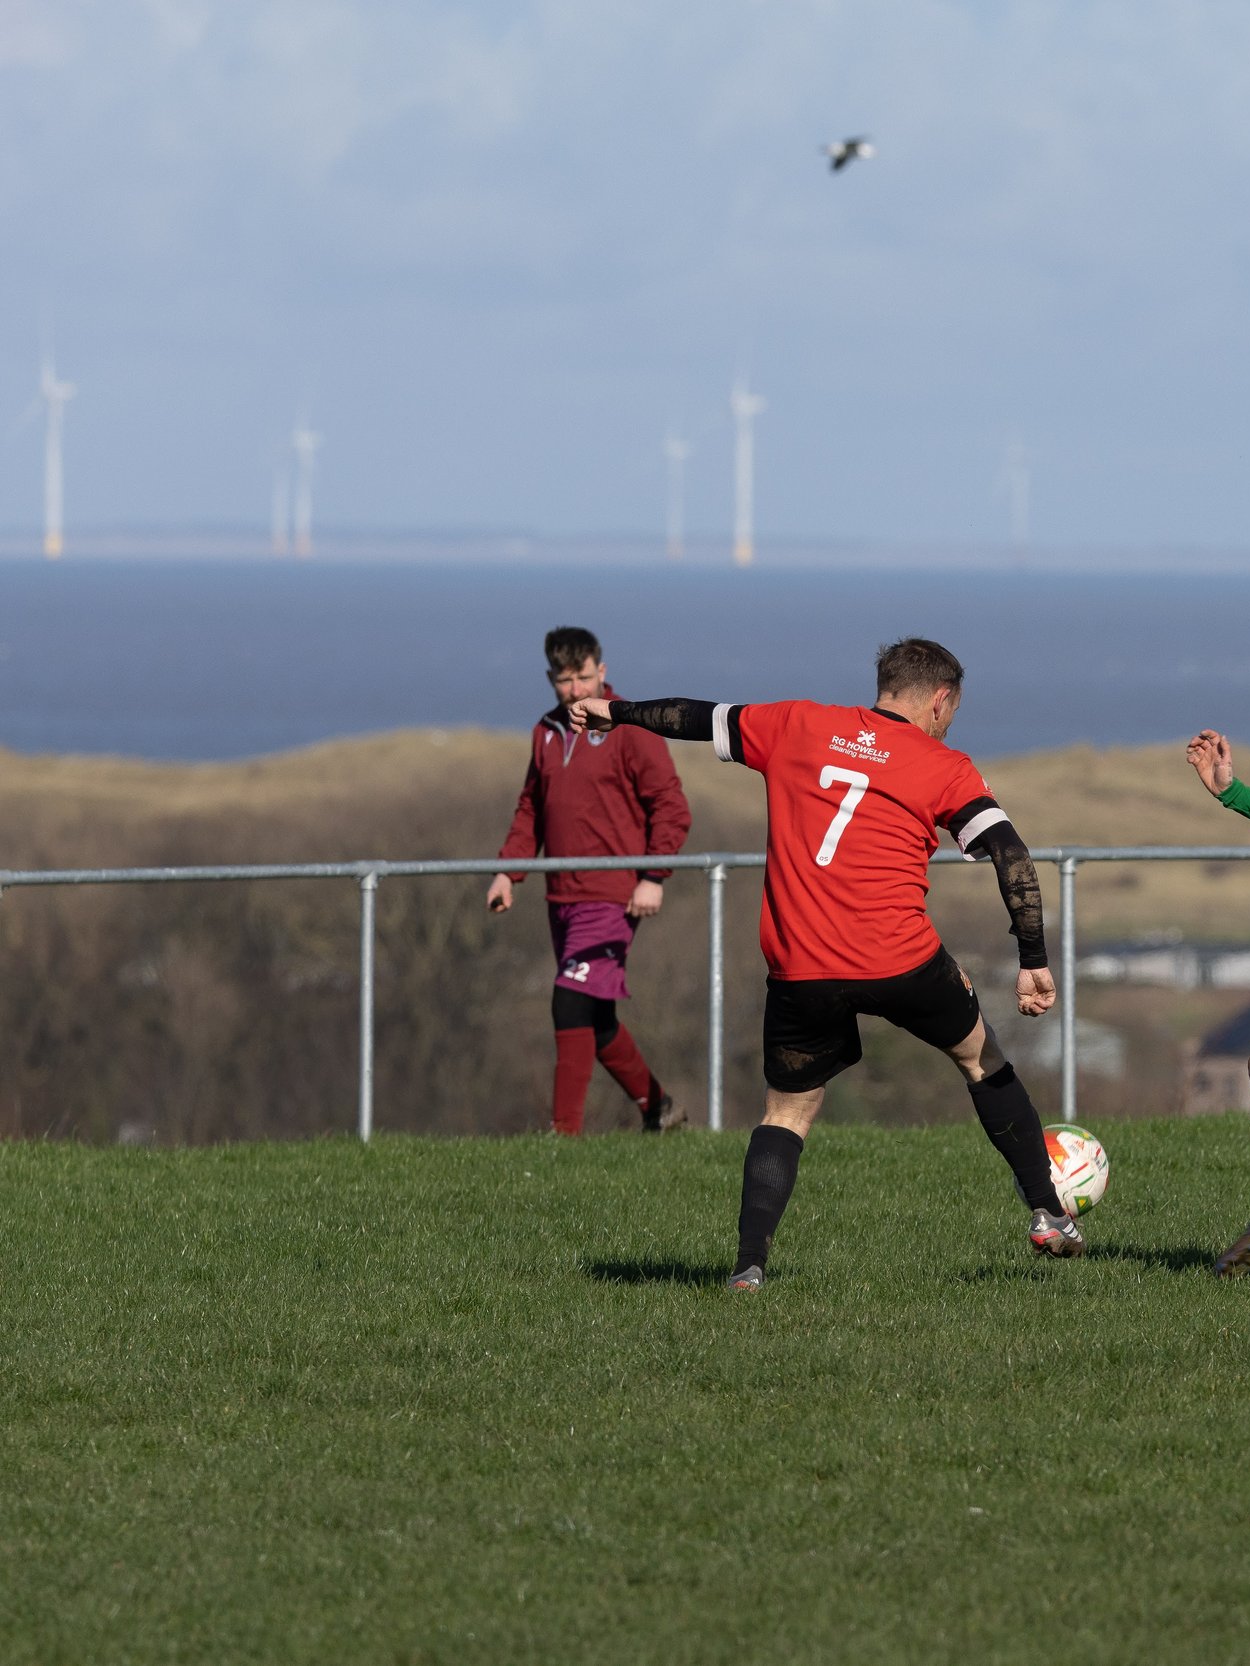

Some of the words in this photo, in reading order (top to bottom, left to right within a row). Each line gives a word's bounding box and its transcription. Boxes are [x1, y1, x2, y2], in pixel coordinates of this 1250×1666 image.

[828, 743, 857, 758] cleaning
[858, 753, 887, 764] services
[831, 735, 846, 746] RG
[846, 741, 890, 759] HOWELLS
[815, 765, 870, 867] 7
[563, 959, 590, 983] 22
